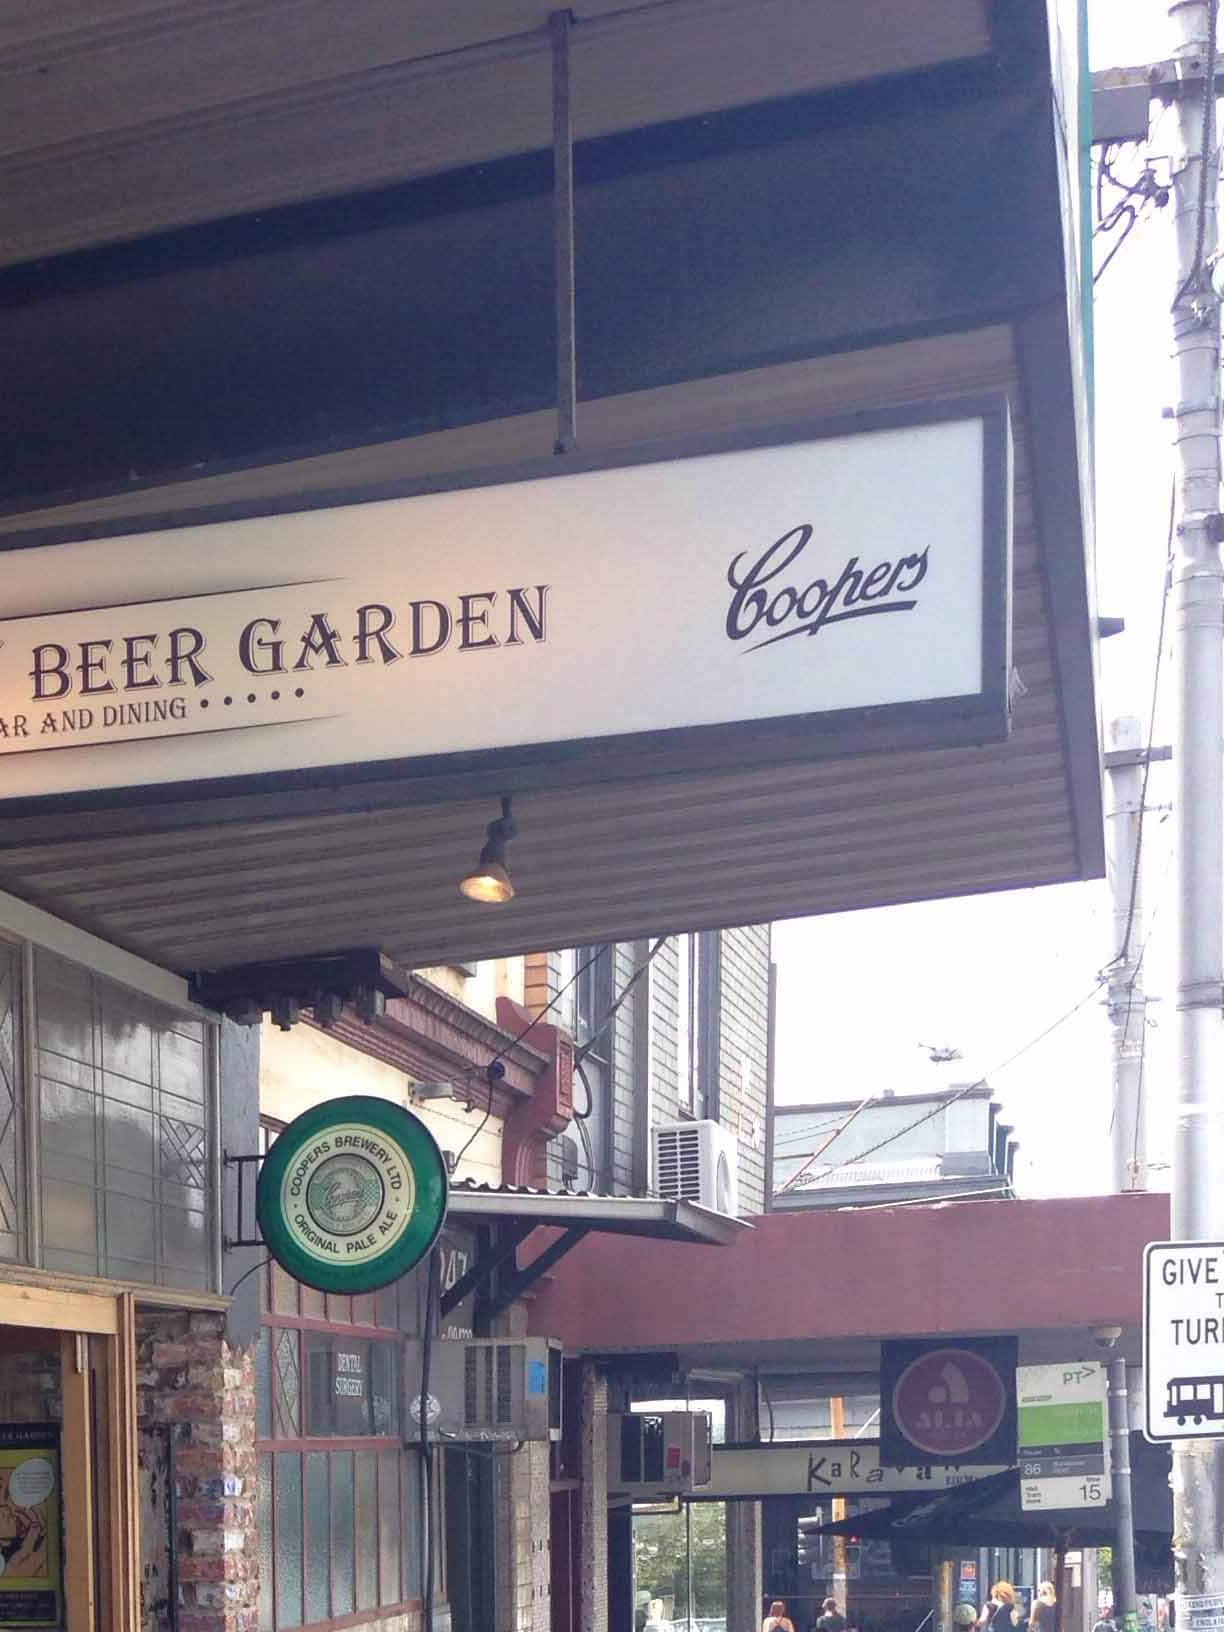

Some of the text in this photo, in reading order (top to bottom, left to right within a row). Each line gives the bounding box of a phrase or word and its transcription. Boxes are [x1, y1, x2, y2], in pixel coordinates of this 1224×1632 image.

[726, 523, 931, 655] Coopers
[30, 627, 214, 703] BEER
[238, 584, 552, 677] GARDEN
[40, 706, 94, 735] AND
[102, 697, 187, 728] DINING
[290, 1135, 402, 1197] COOPERS BREWERY LTD
[294, 1211, 398, 1254] ORIGINAL PALE ALE
[1162, 1257, 1219, 1286] GIVE
[1170, 1317, 1224, 1346] TUR
[1024, 1463, 1041, 1475] 86
[1079, 1484, 1102, 1501] 15
